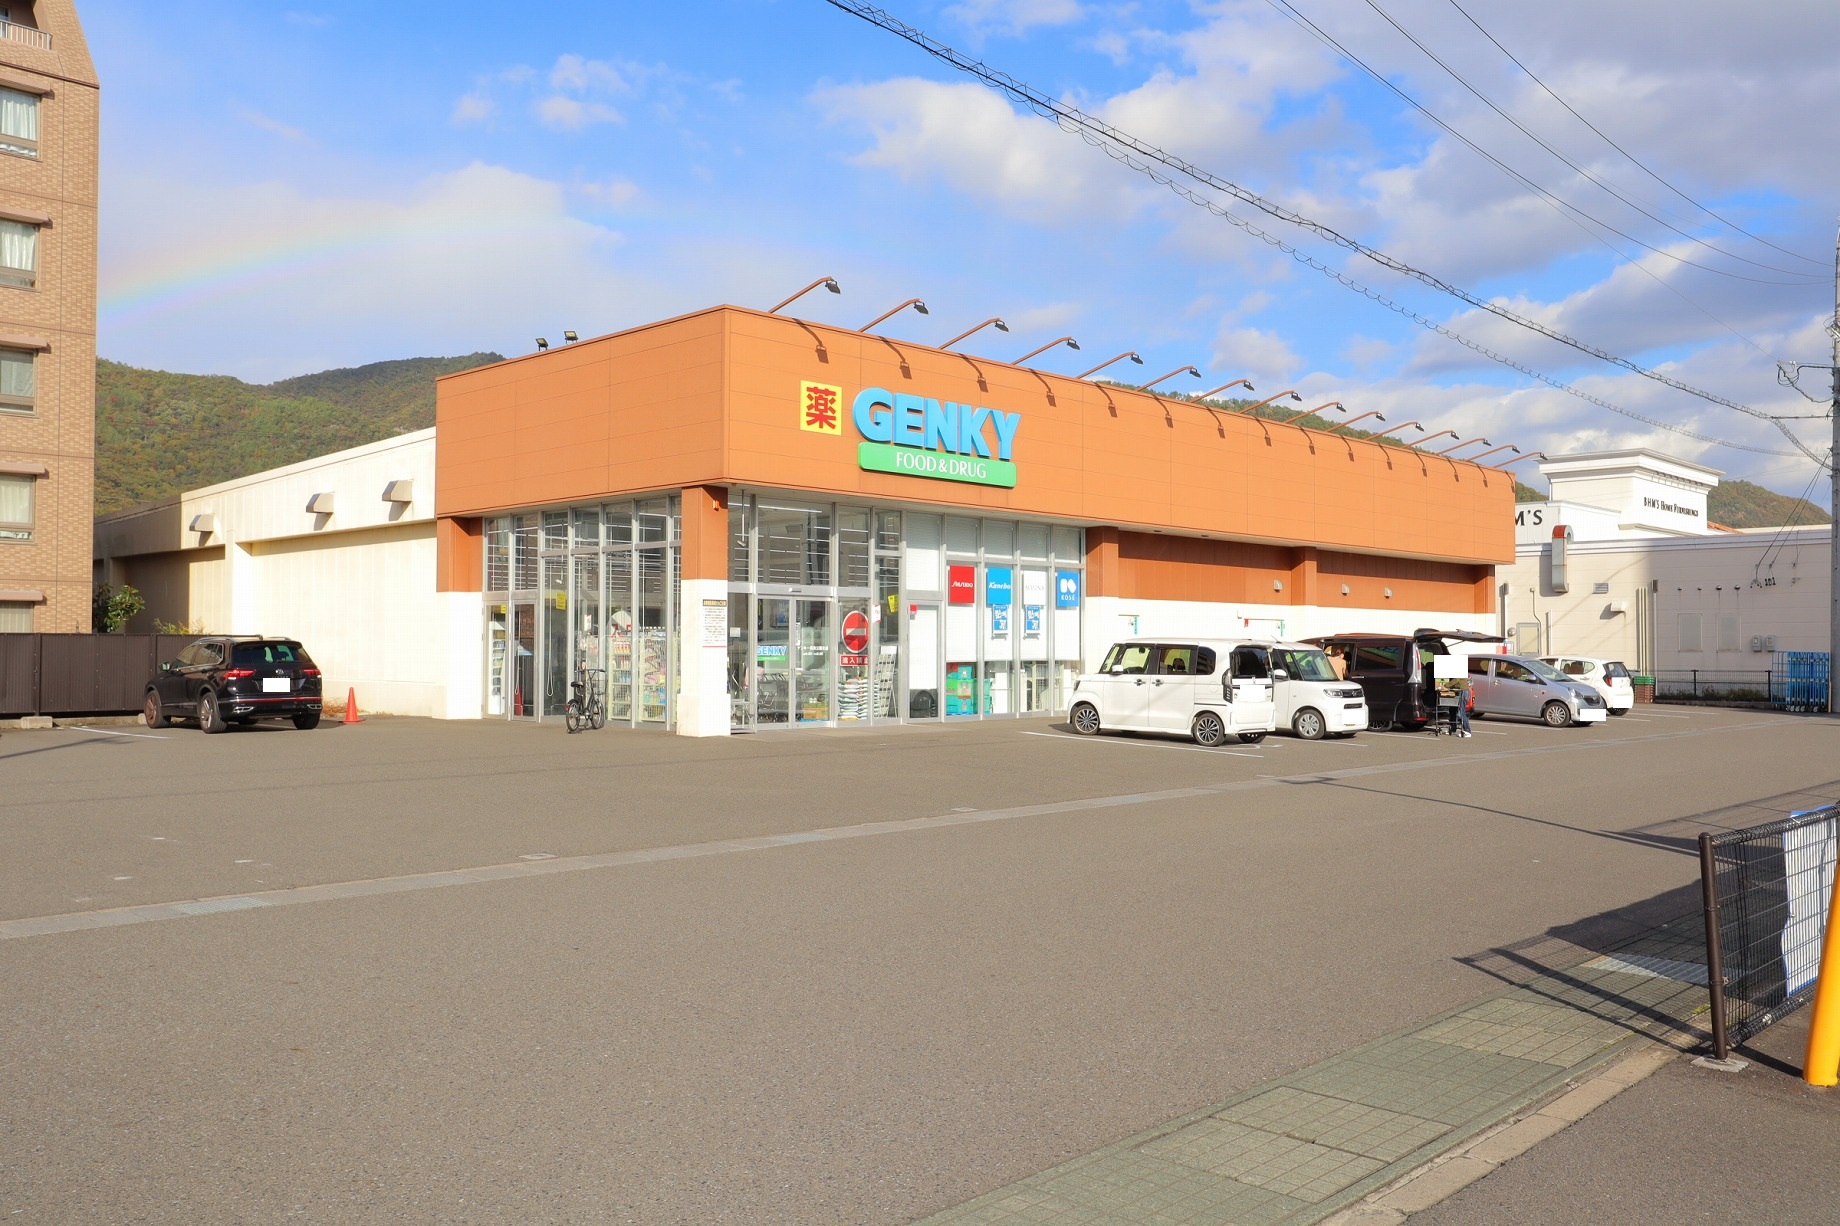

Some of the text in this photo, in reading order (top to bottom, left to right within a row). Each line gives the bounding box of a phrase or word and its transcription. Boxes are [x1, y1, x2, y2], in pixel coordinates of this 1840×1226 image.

[806, 386, 836, 429] 薬
[852, 387, 1021, 461] GENKY
[896, 451, 937, 471] FOOD
[949, 459, 987, 479] DRUG
[988, 581, 1011, 590] Kanebo
[757, 645, 787, 656] GENKY
